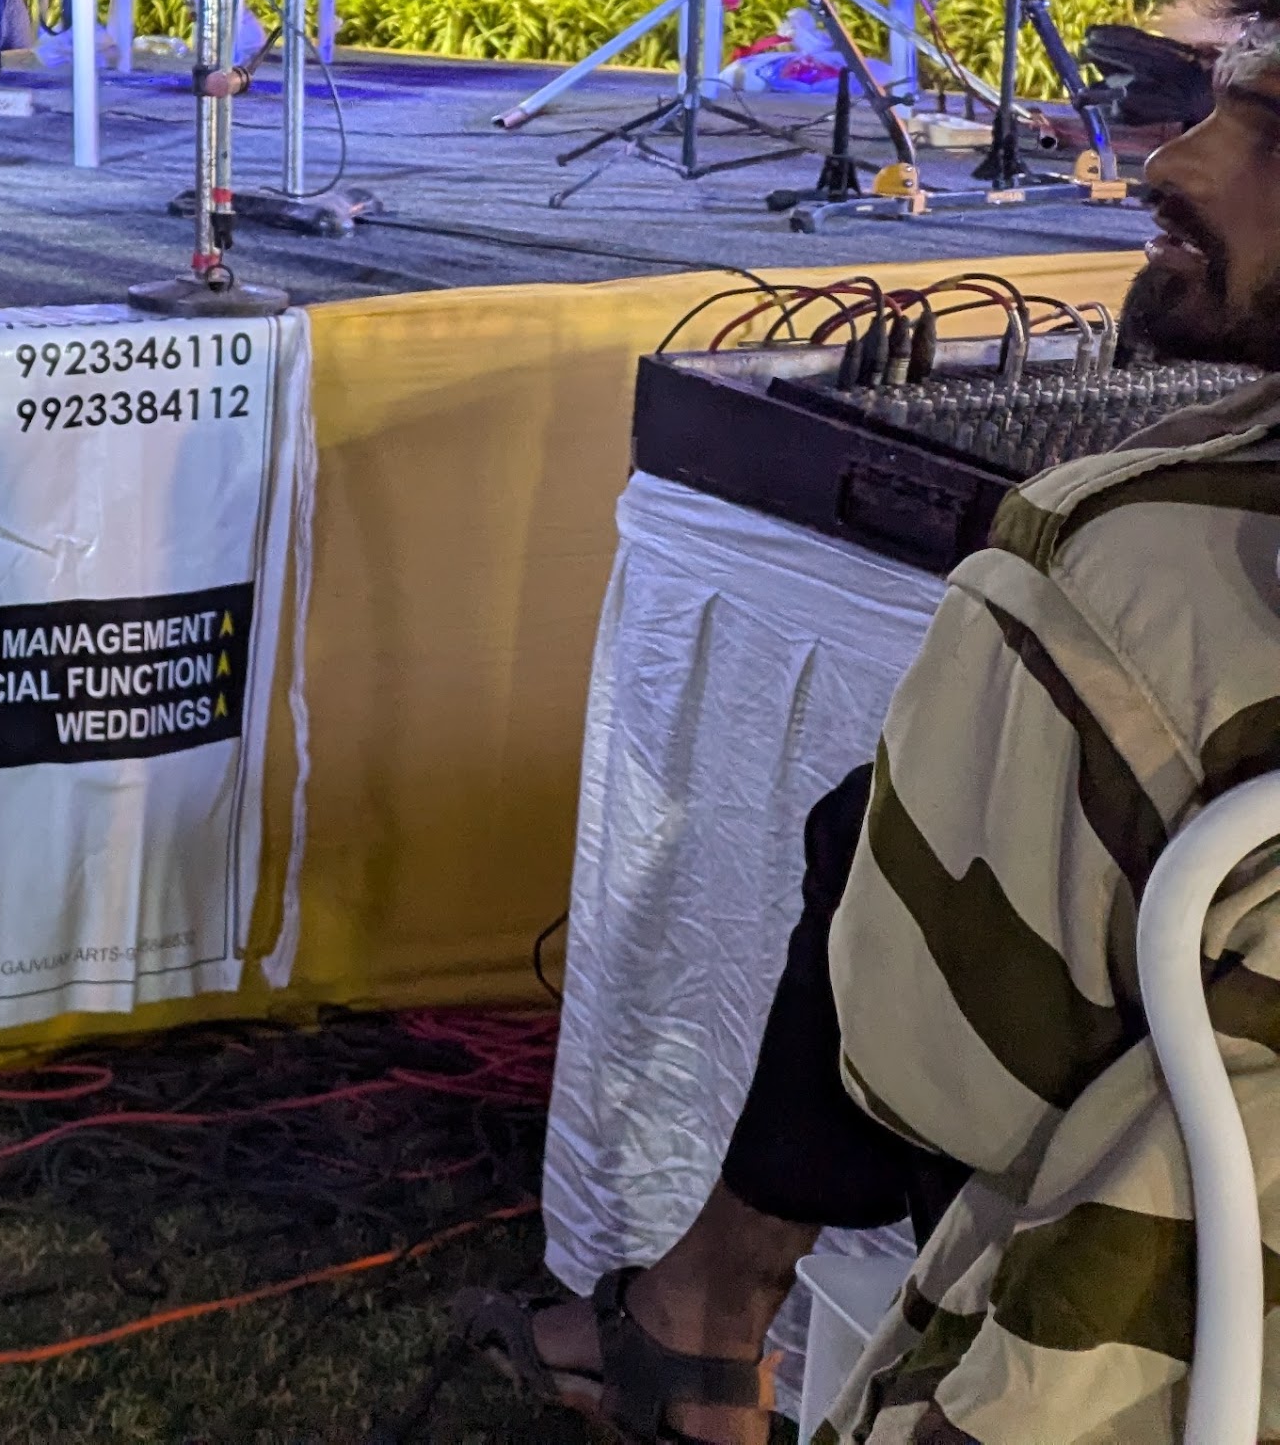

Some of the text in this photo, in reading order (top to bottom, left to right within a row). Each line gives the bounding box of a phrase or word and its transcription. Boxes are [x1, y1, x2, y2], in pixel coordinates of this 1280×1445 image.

[16, 332, 252, 379] 9923346110
[16, 384, 250, 433] 9923384112
[1, 610, 218, 660] MANAGEMENT
[66, 652, 213, 700] FUNCTION
[55, 695, 212, 745] WEDDINGS
